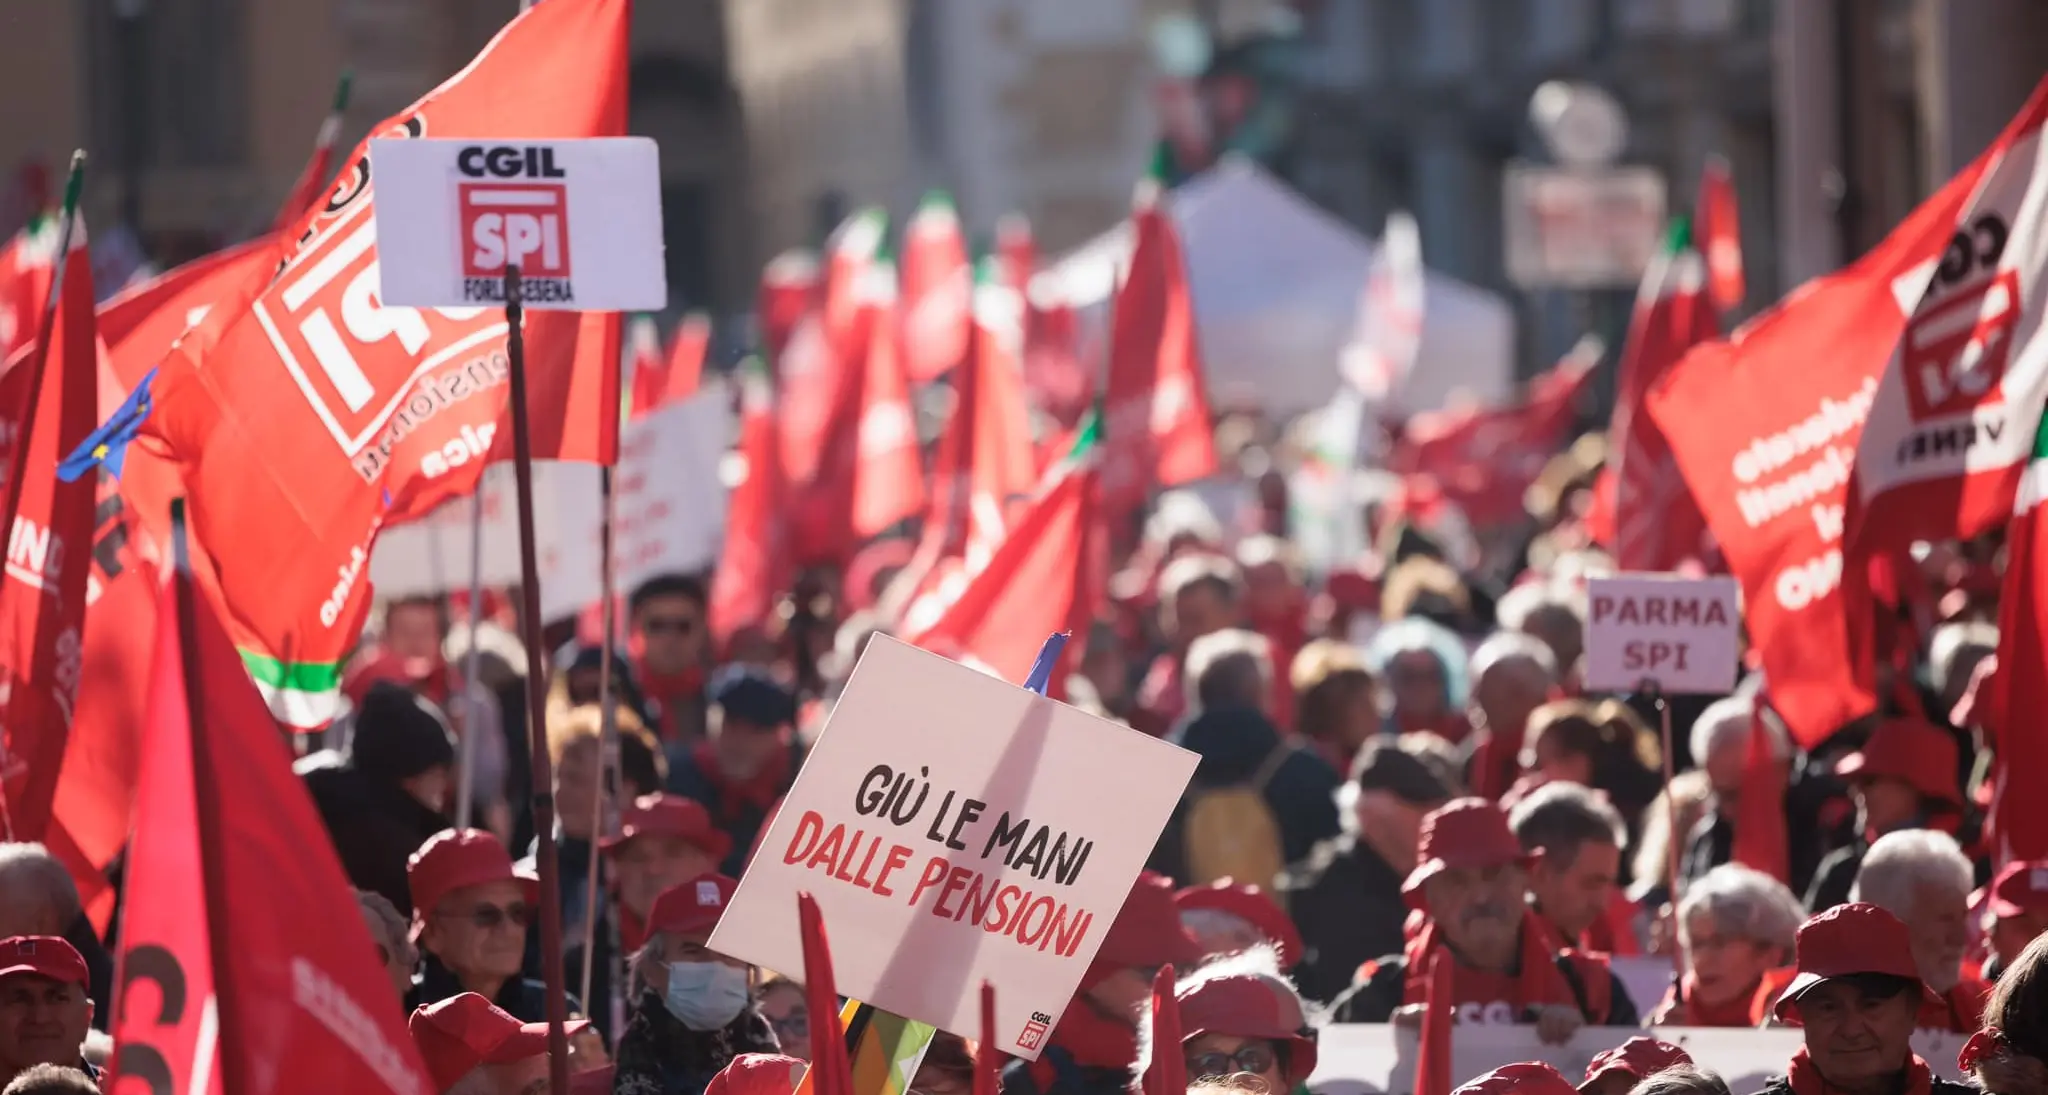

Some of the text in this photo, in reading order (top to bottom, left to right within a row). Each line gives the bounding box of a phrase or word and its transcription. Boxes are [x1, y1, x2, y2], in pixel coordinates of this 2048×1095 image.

[458, 146, 565, 178] CGIL
[472, 213, 560, 270] SPI
[1593, 596, 1728, 626] PARMA
[1623, 641, 1690, 672] SPI
[855, 764, 1094, 886] GIÙ LE MANI
[783, 810, 1094, 958] DALLE PENSIONI
[1031, 1011, 1051, 1025] CGIL
[1019, 1029, 1042, 1049] SPI
